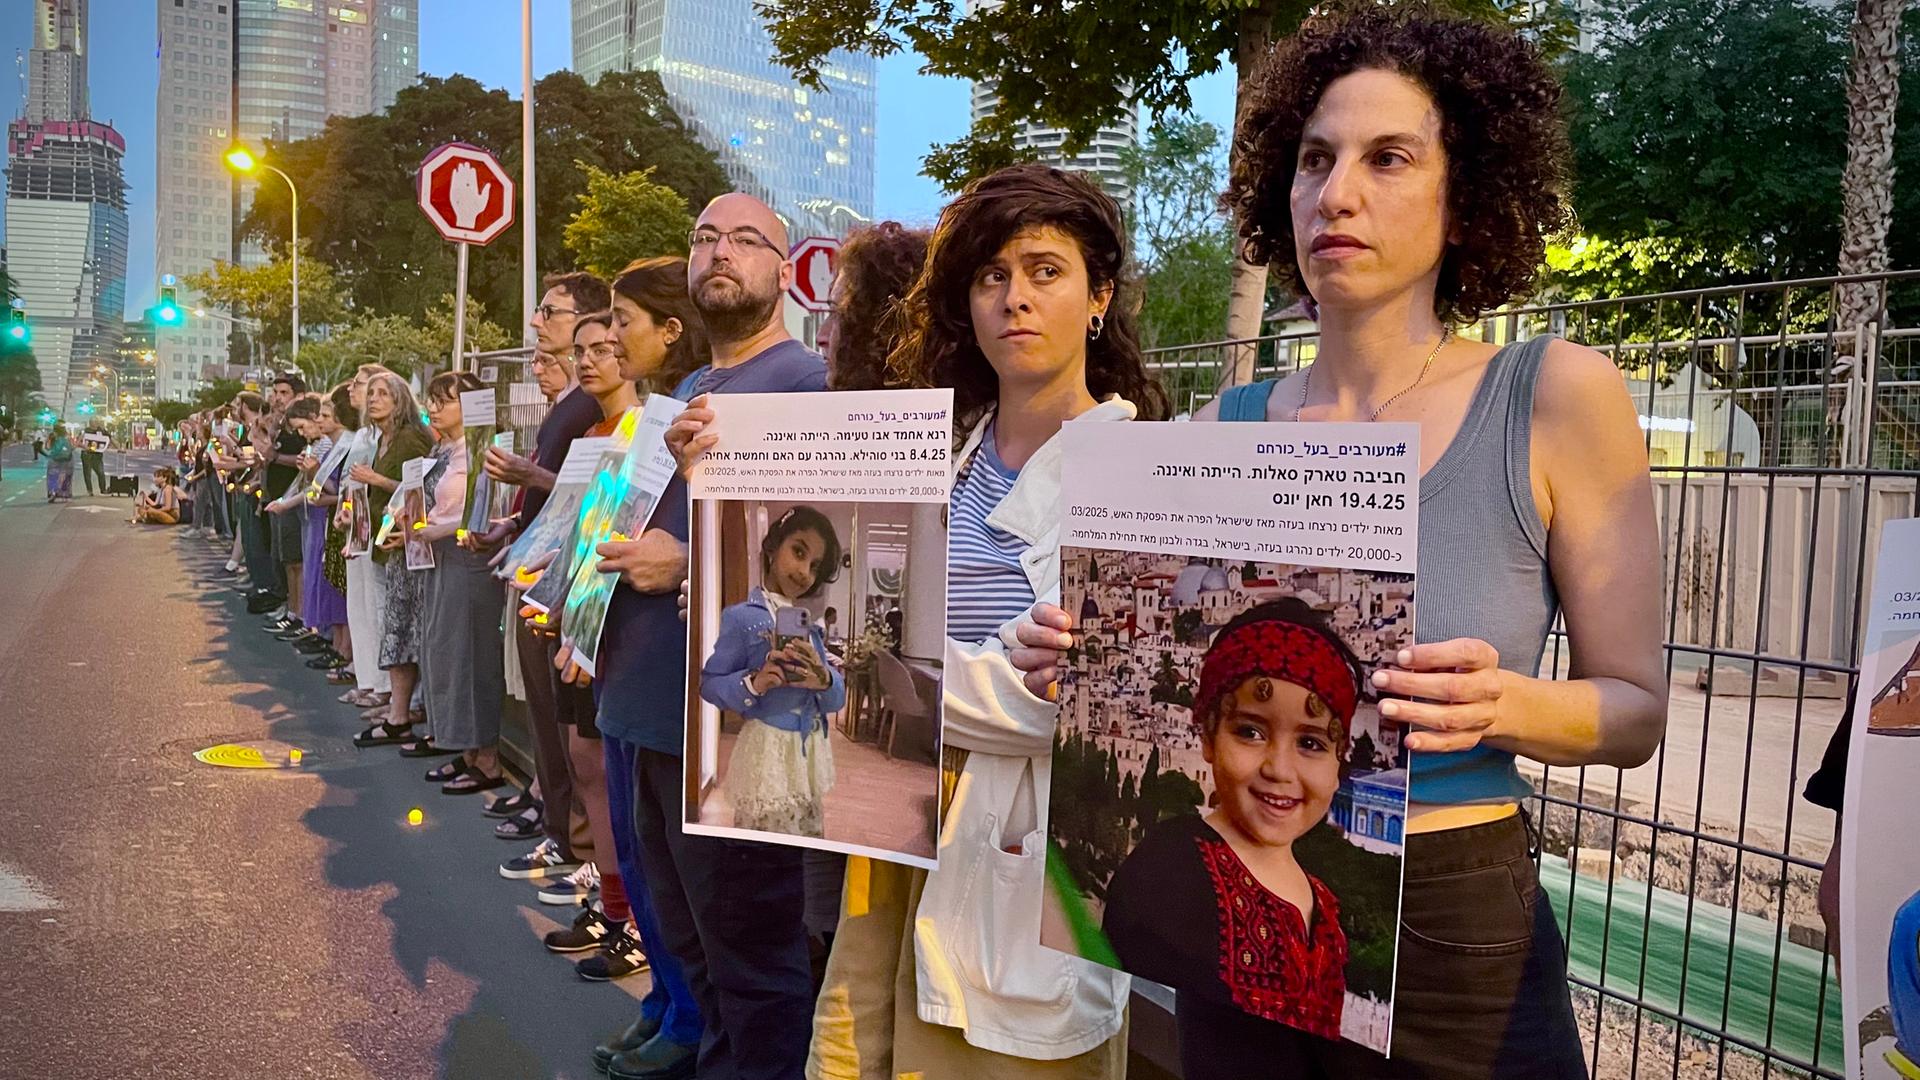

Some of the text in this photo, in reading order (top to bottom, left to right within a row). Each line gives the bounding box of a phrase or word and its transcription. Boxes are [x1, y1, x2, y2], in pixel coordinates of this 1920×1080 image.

[848, 410, 946, 423] #מעורבים_בעל_כורחם
[763, 431, 946, 441] רנא אחמד אבו טעימה. הייתה ואיננה.
[701, 449, 945, 461] 8.4.25 בני סוהילא. נהרגה עם האם וחמשת אחיה.
[1257, 442, 1406, 458] #מעורבים_בעל_כורחם
[1153, 465, 1405, 484] חביבה טארק סאלות. הייתה ואיננה.
[1273, 492, 1405, 510] 19.4.25 חאן יונס
[1111, 511, 1133, 521] האש,
[1136, 512, 1167, 522] הפסקת
[1170, 514, 1184, 522] את
[1187, 515, 1212, 524] הפרה
[1216, 514, 1253, 527] שישראל
[1257, 519, 1275, 528] מאז
[1279, 520, 1304, 530] בעזה
[1309, 522, 1337, 532] נרצחו
[1342, 522, 1369, 533] ילדים
[1373, 525, 1402, 535] מאות
[1110, 531, 1137, 542] תחילת
[1140, 535, 1156, 543] מאז
[1160, 535, 1182, 545] ולבנון
[1185, 538, 1208, 547] בגדה
[1213, 538, 1250, 550] בישראל,
[1254, 543, 1282, 553] בעזה,
[1286, 545, 1312, 555] נהרגו
[1317, 546, 1343, 556] ילדים
[543, 851, 564, 866] N
[586, 921, 607, 939] N
[624, 949, 646, 966] N
